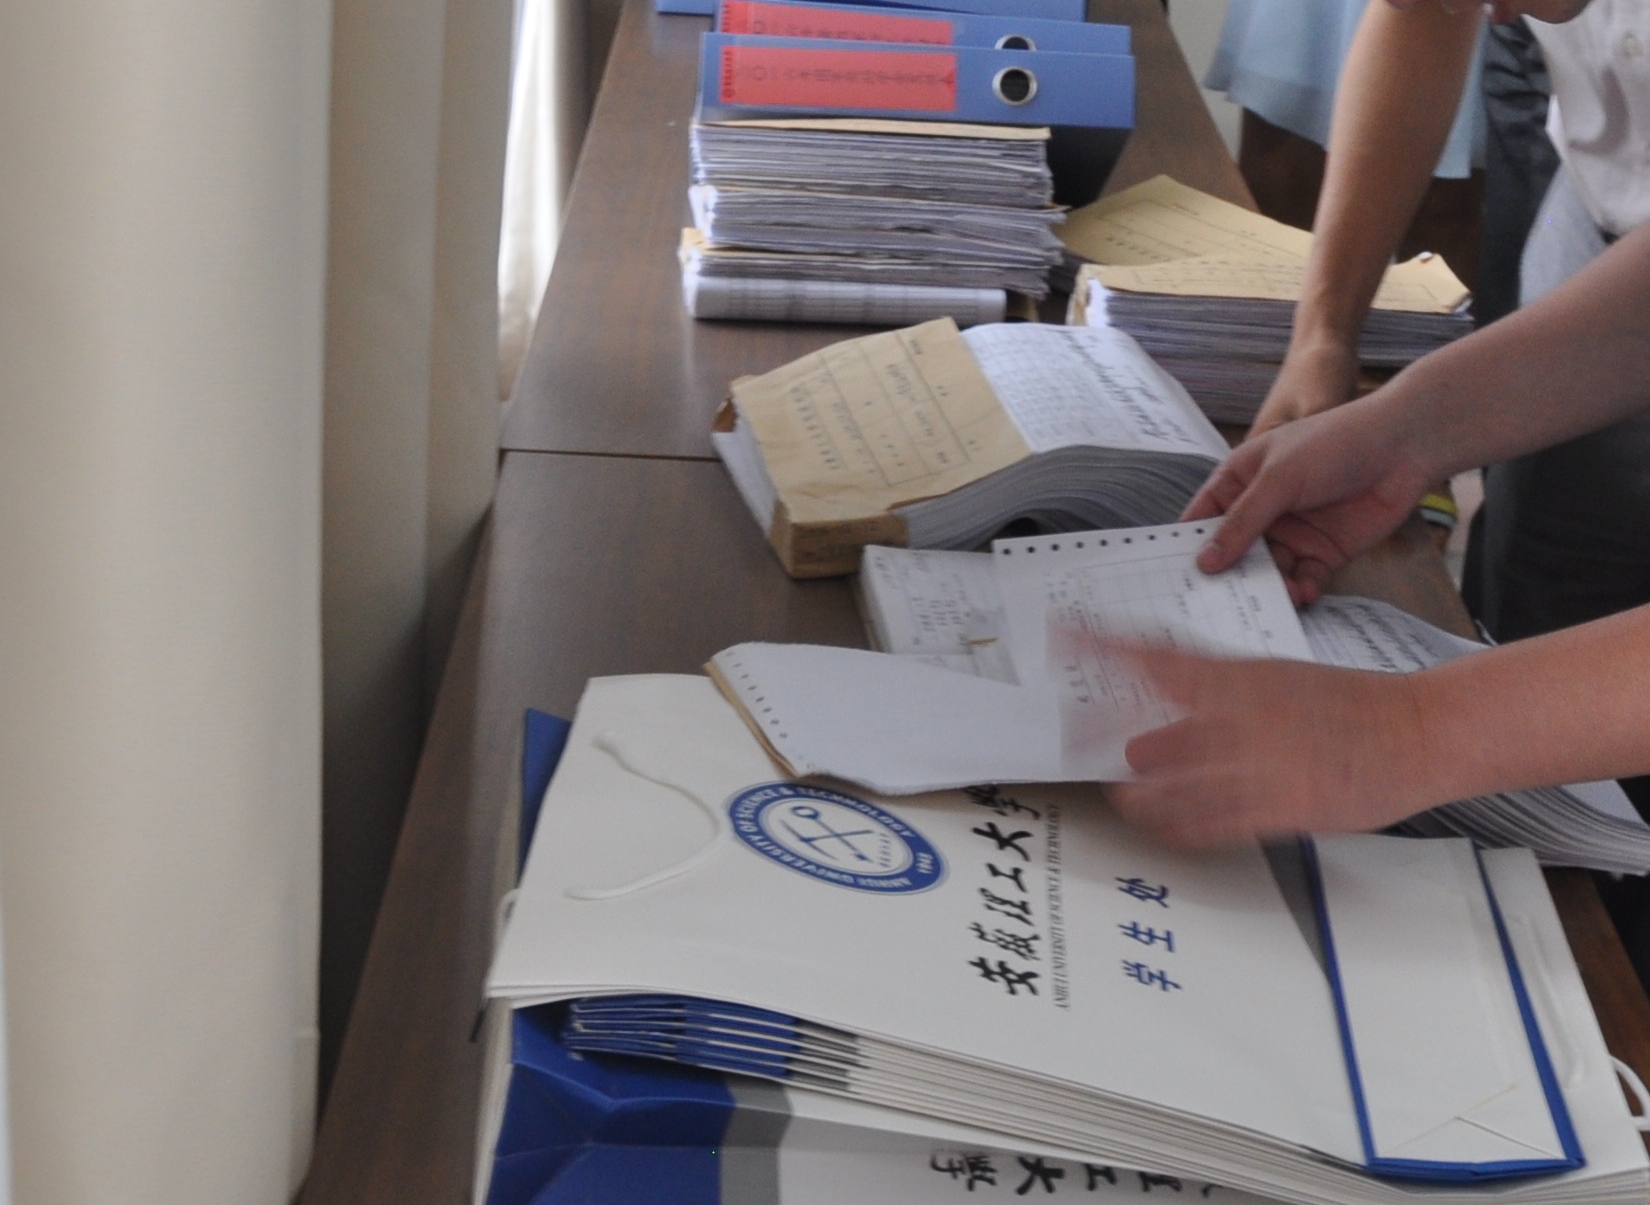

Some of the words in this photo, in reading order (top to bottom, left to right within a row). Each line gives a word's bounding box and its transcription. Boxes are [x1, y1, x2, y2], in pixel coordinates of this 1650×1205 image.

[745, 834, 856, 885] UNIVERSITY
[1115, 875, 1183, 992] 学生处
